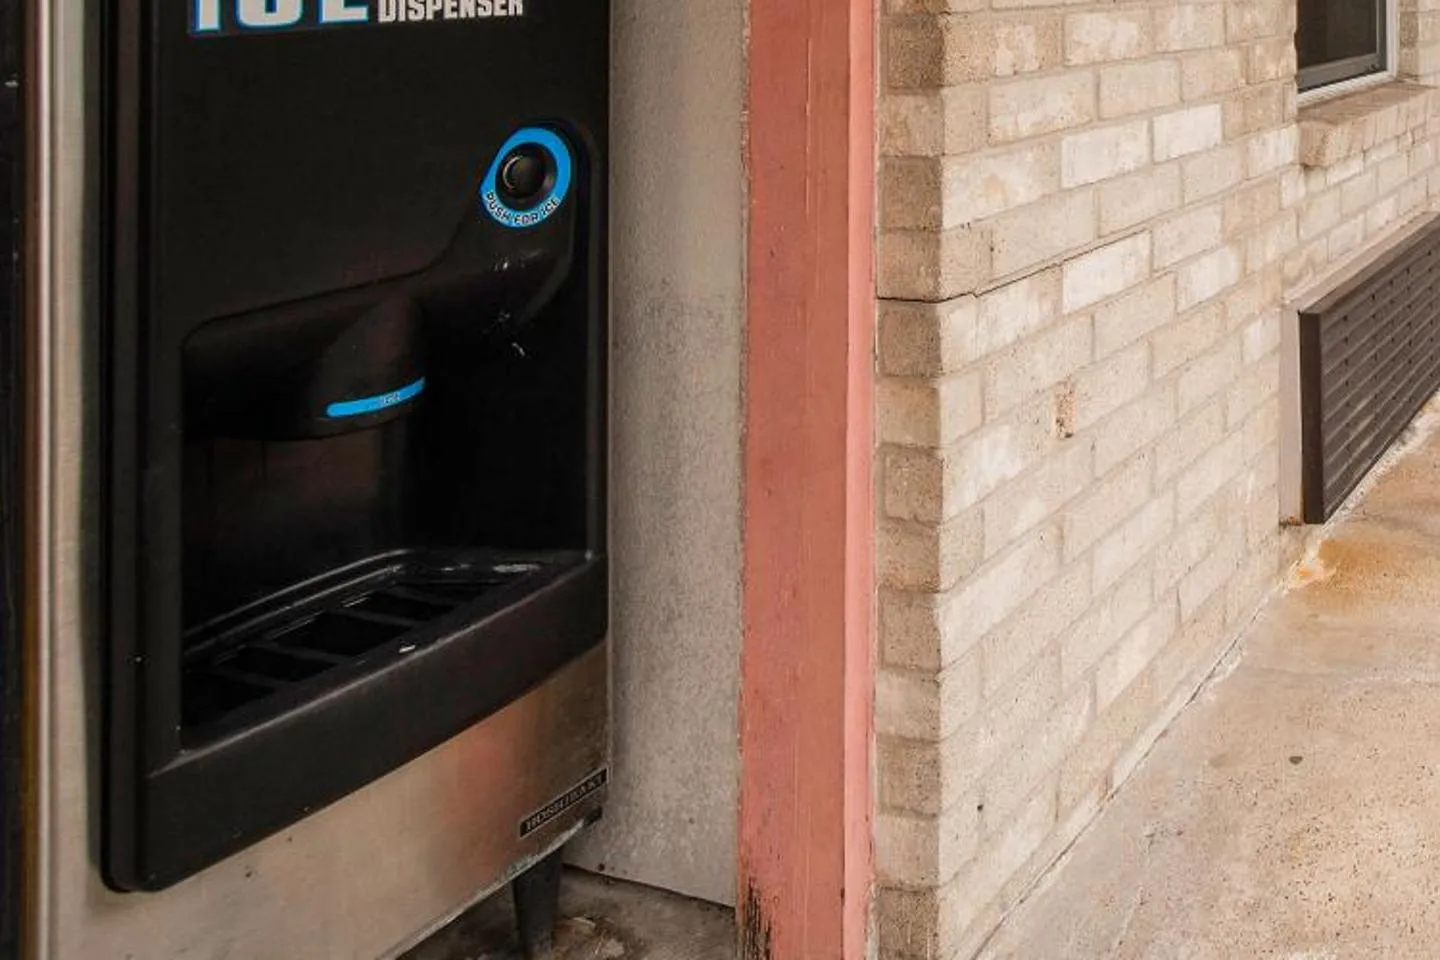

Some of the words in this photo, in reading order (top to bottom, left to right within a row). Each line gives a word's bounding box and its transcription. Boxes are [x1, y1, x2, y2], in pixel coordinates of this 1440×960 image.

[485, 191, 511, 221] PUSH
[514, 214, 539, 225] FOR
[540, 197, 560, 217] ICE
